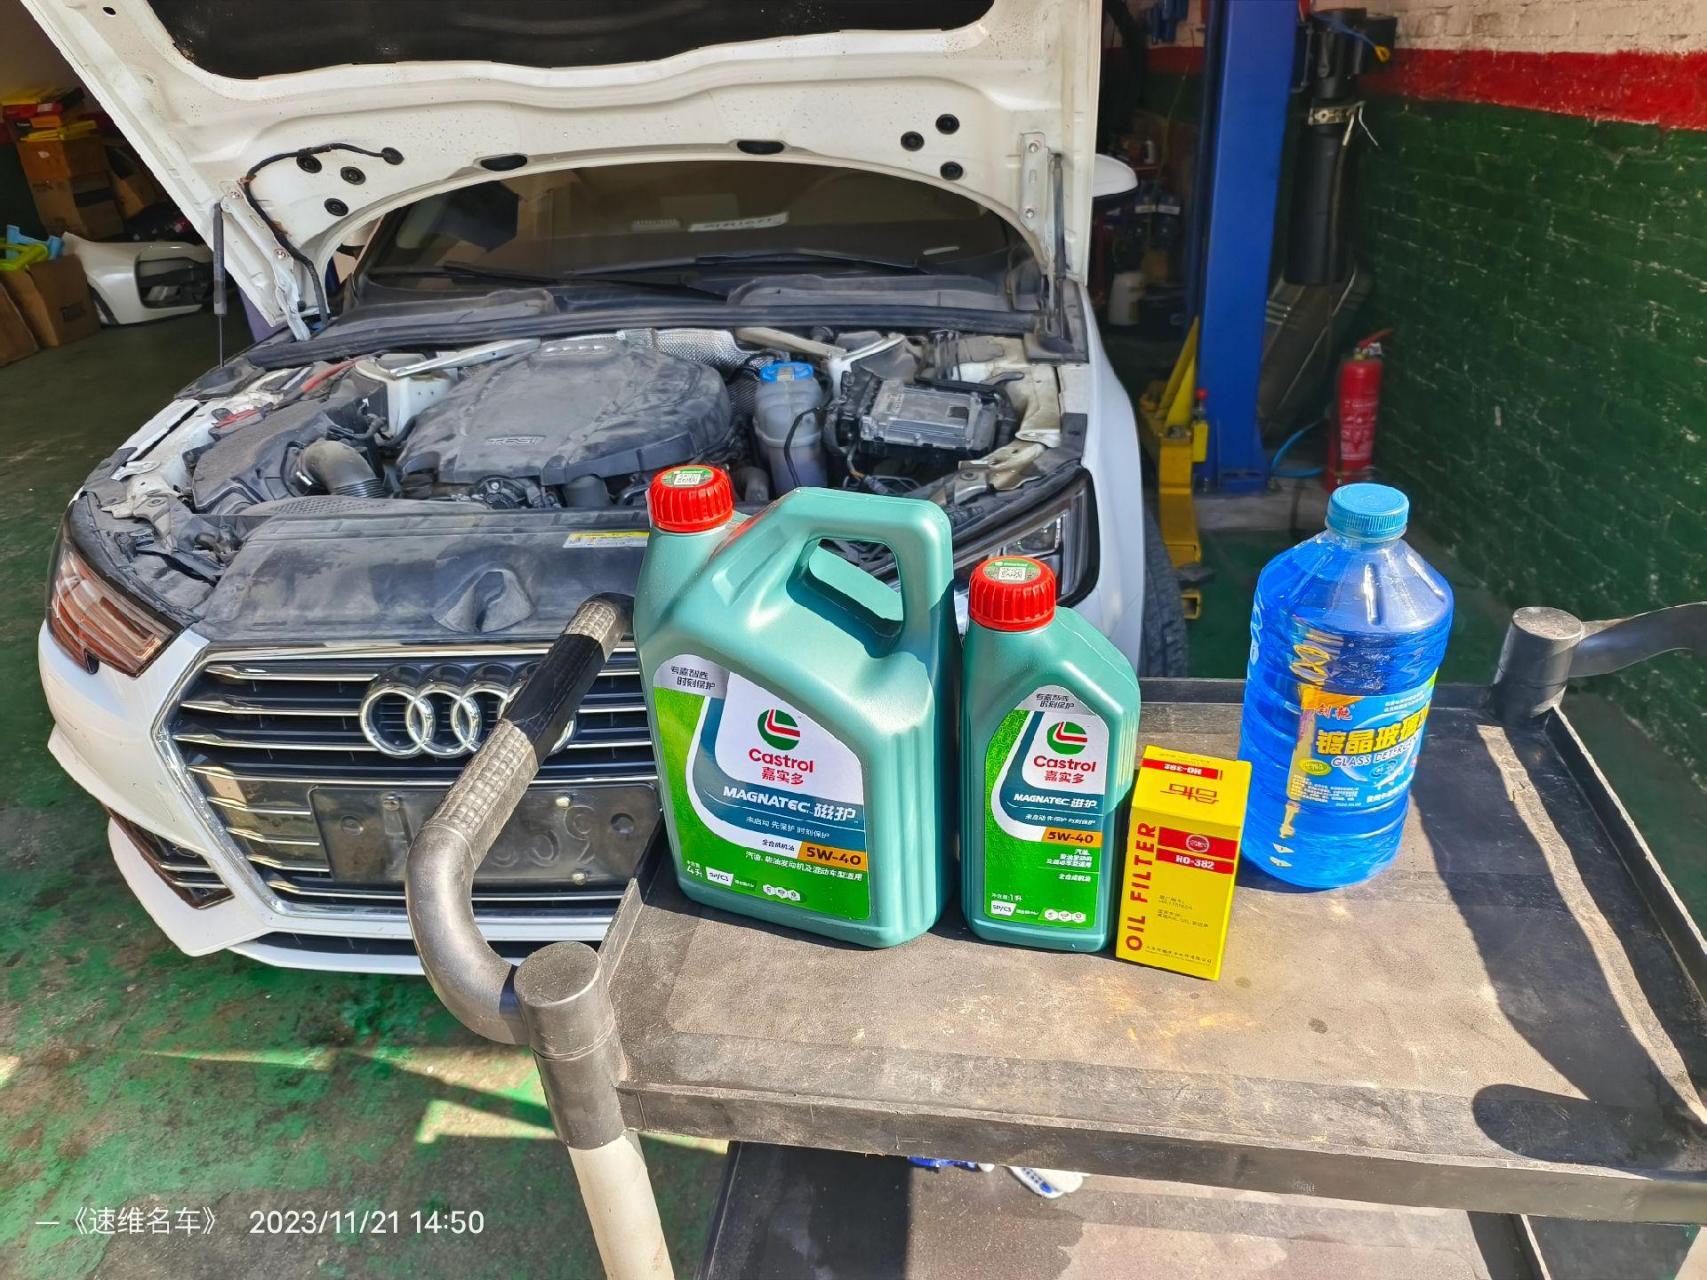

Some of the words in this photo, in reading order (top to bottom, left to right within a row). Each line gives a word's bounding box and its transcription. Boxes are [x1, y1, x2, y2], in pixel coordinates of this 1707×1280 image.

[677, 677, 716, 690] 时刻保护
[748, 748, 814, 773] Castrol
[1033, 755, 1097, 772] Castrol
[1332, 755, 1371, 767] GLASS
[762, 766, 804, 785] 嘉实多
[1045, 770, 1085, 784] 嘉实多
[723, 785, 811, 814] MAGNATEC
[813, 802, 857, 821] 磁护
[1014, 793, 1070, 806] MAGNATEC
[1071, 798, 1098, 808] 磁护
[771, 820, 796, 832] 先保护
[796, 826, 831, 839] 时刻保护
[1047, 831, 1095, 844] 5W-40
[762, 838, 796, 852] 全合成机油
[806, 846, 862, 866] 5W-40
[1129, 822, 1157, 904] FILTER
[1175, 853, 1216, 870] HO-382
[1125, 915, 1147, 951] OIL
